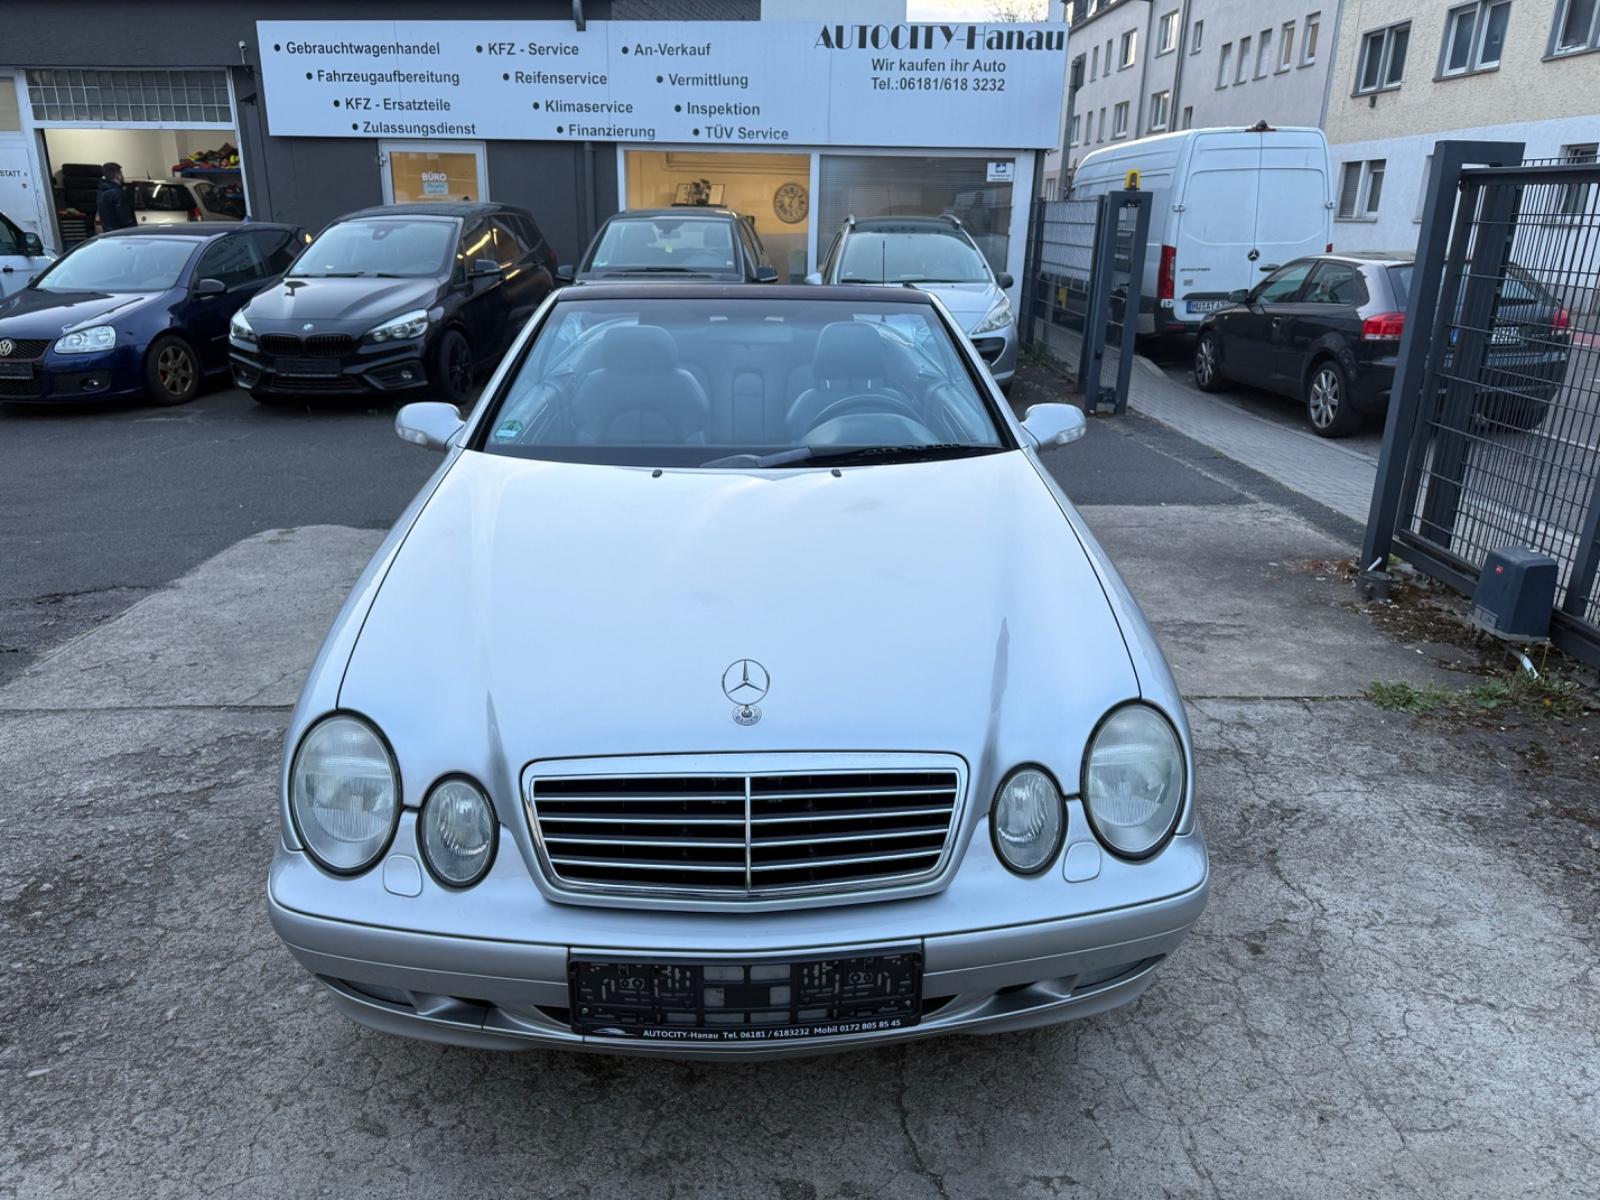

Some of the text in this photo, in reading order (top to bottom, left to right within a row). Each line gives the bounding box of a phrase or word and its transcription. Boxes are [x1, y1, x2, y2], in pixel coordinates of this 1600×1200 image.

[814, 24, 1065, 51] AUTOCITY-Hanau
[286, 41, 440, 58] Gebrauchtwagenhandel
[487, 42, 516, 56] KFZ
[528, 42, 580, 56] Service
[634, 42, 711, 56] An-Verkauf
[871, 57, 1006, 73] Wir kaufen ihr Auto
[316, 69, 460, 87] Fahrzeugaufbereitung
[514, 70, 608, 85] Reifenservice
[668, 73, 749, 89] Vermittlung
[871, 76, 1006, 92] Tel.:06181/618 3232
[345, 97, 372, 111] KFZ
[383, 97, 451, 112] Ersatzteile
[545, 99, 634, 114] Klimaservice
[687, 101, 761, 117] Inspektion
[362, 121, 477, 136] Zulassungsdienst
[568, 123, 656, 140] Finanzierung
[704, 123, 790, 140] TÜV Service
[422, 171, 447, 181] BÜRO
[643, 1029, 719, 1040] AUTOCITY-Hanau
[740, 1030, 766, 1038] 06181
[773, 1027, 810, 1038] 6183232
[814, 1025, 838, 1034] Mobil
[840, 1023, 860, 1032] 0172
[862, 1021, 877, 1030] 805
[891, 1018, 901, 1027] 45
